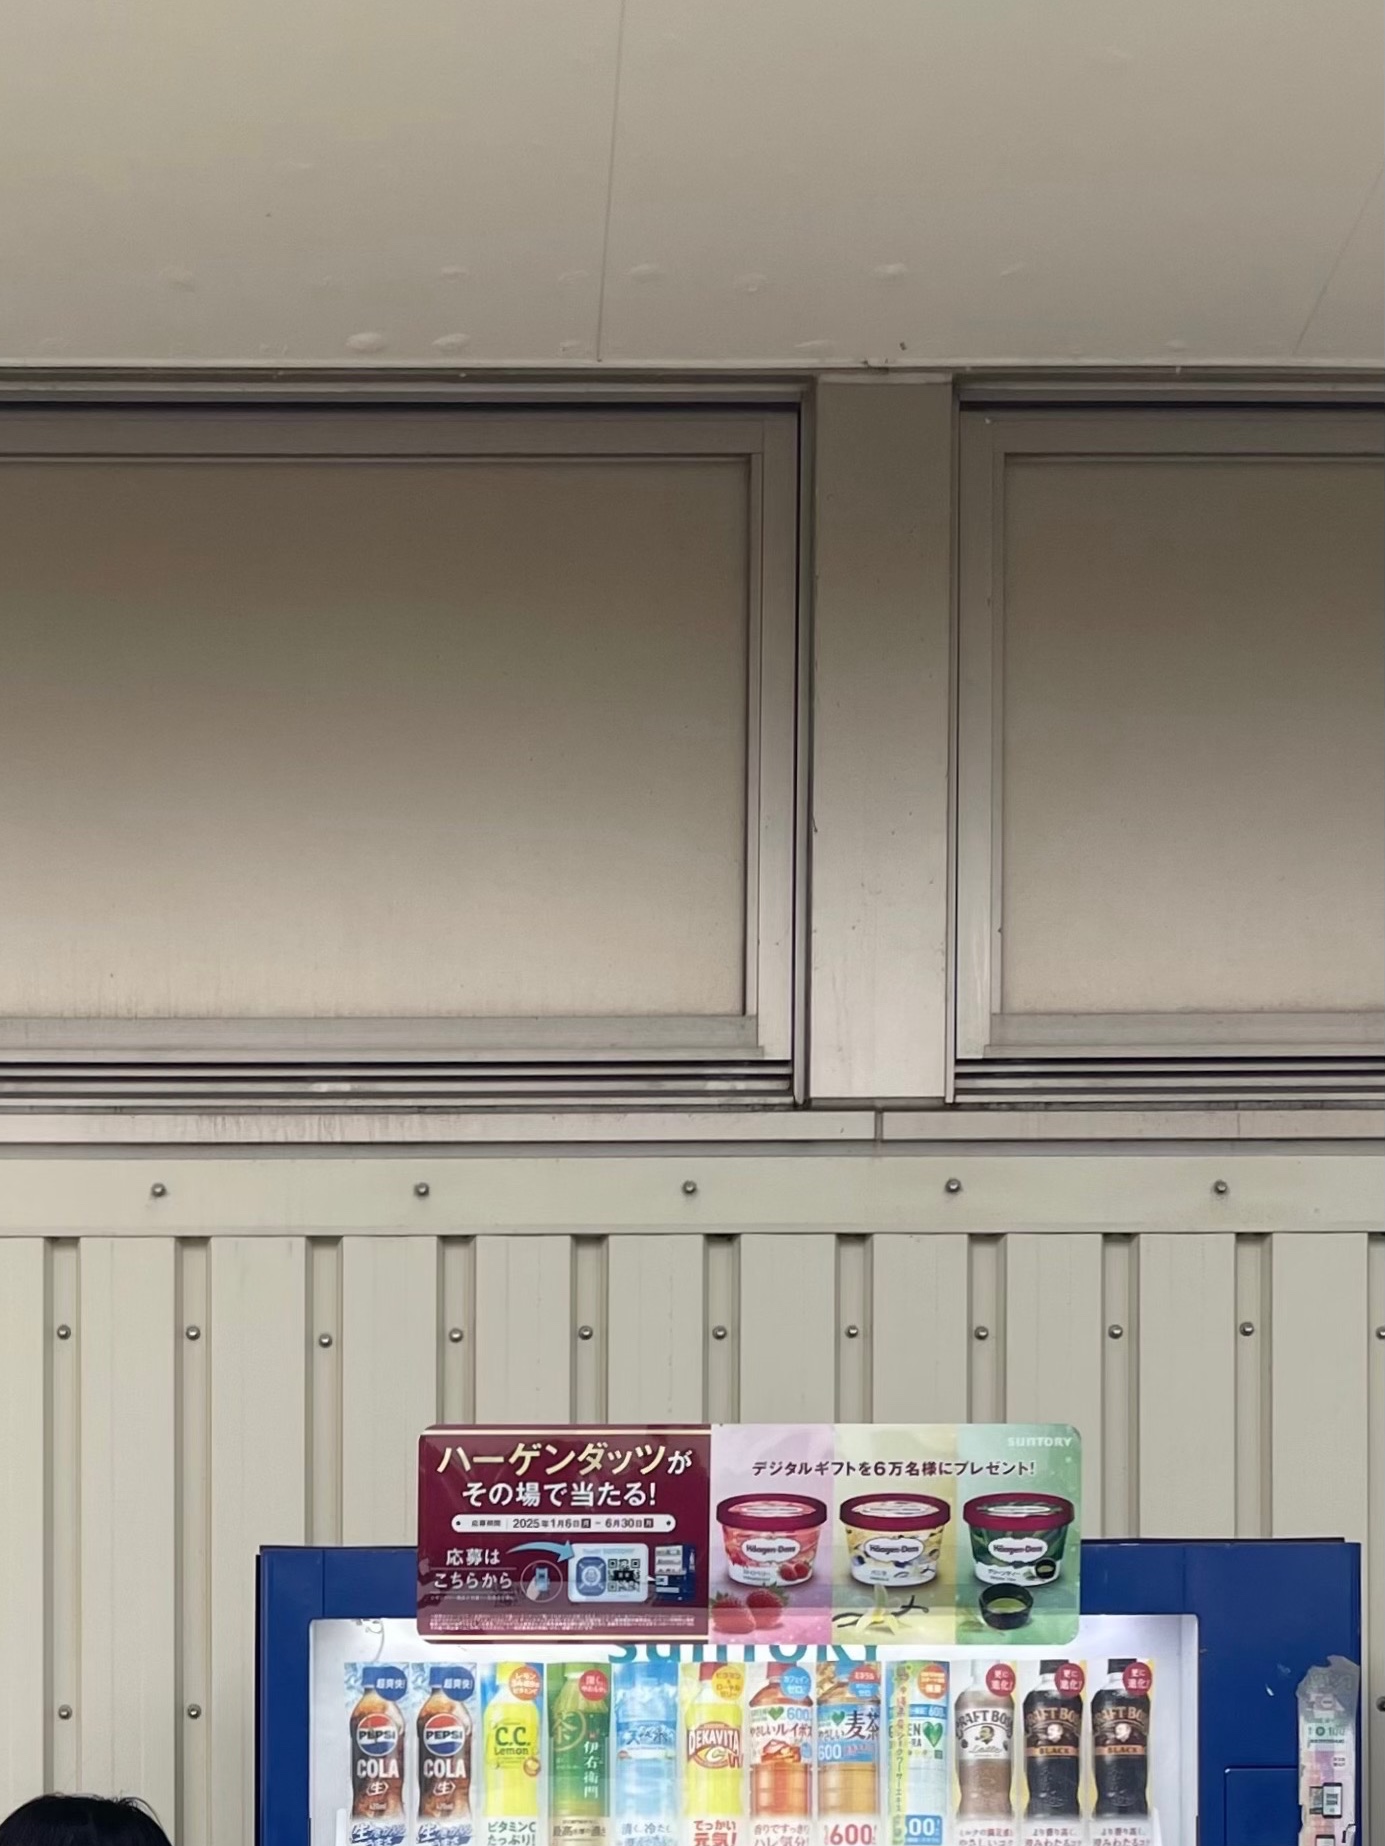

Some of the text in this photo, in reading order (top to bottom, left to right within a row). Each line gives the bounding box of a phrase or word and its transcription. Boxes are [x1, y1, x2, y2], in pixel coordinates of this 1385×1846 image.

[436, 1442, 692, 1476] ハーゲンダッツが
[752, 1460, 1036, 1477] デジタルギフトを6万名様にプレゼント!
[463, 1481, 656, 1507] その場で当たる!
[446, 1548, 500, 1566] 応募は
[433, 1572, 513, 1590] こちらから
[846, 1709, 880, 1740] 麦茶
[358, 1730, 396, 1740] PEPSI
[426, 1730, 464, 1740] PEPSI
[495, 1727, 531, 1747] C.C.
[688, 1729, 741, 1755] DEKAVITA
[494, 1747, 529, 1756] Lemon
[818, 1744, 841, 1760] 600
[357, 1759, 400, 1778] COLA
[424, 1759, 467, 1778] COLA
[584, 1740, 599, 1799] 伊右衛門
[488, 1822, 536, 1832] ビタミンC
[830, 1824, 872, 1846] 600
[488, 1834, 536, 1846] たっぷり!
